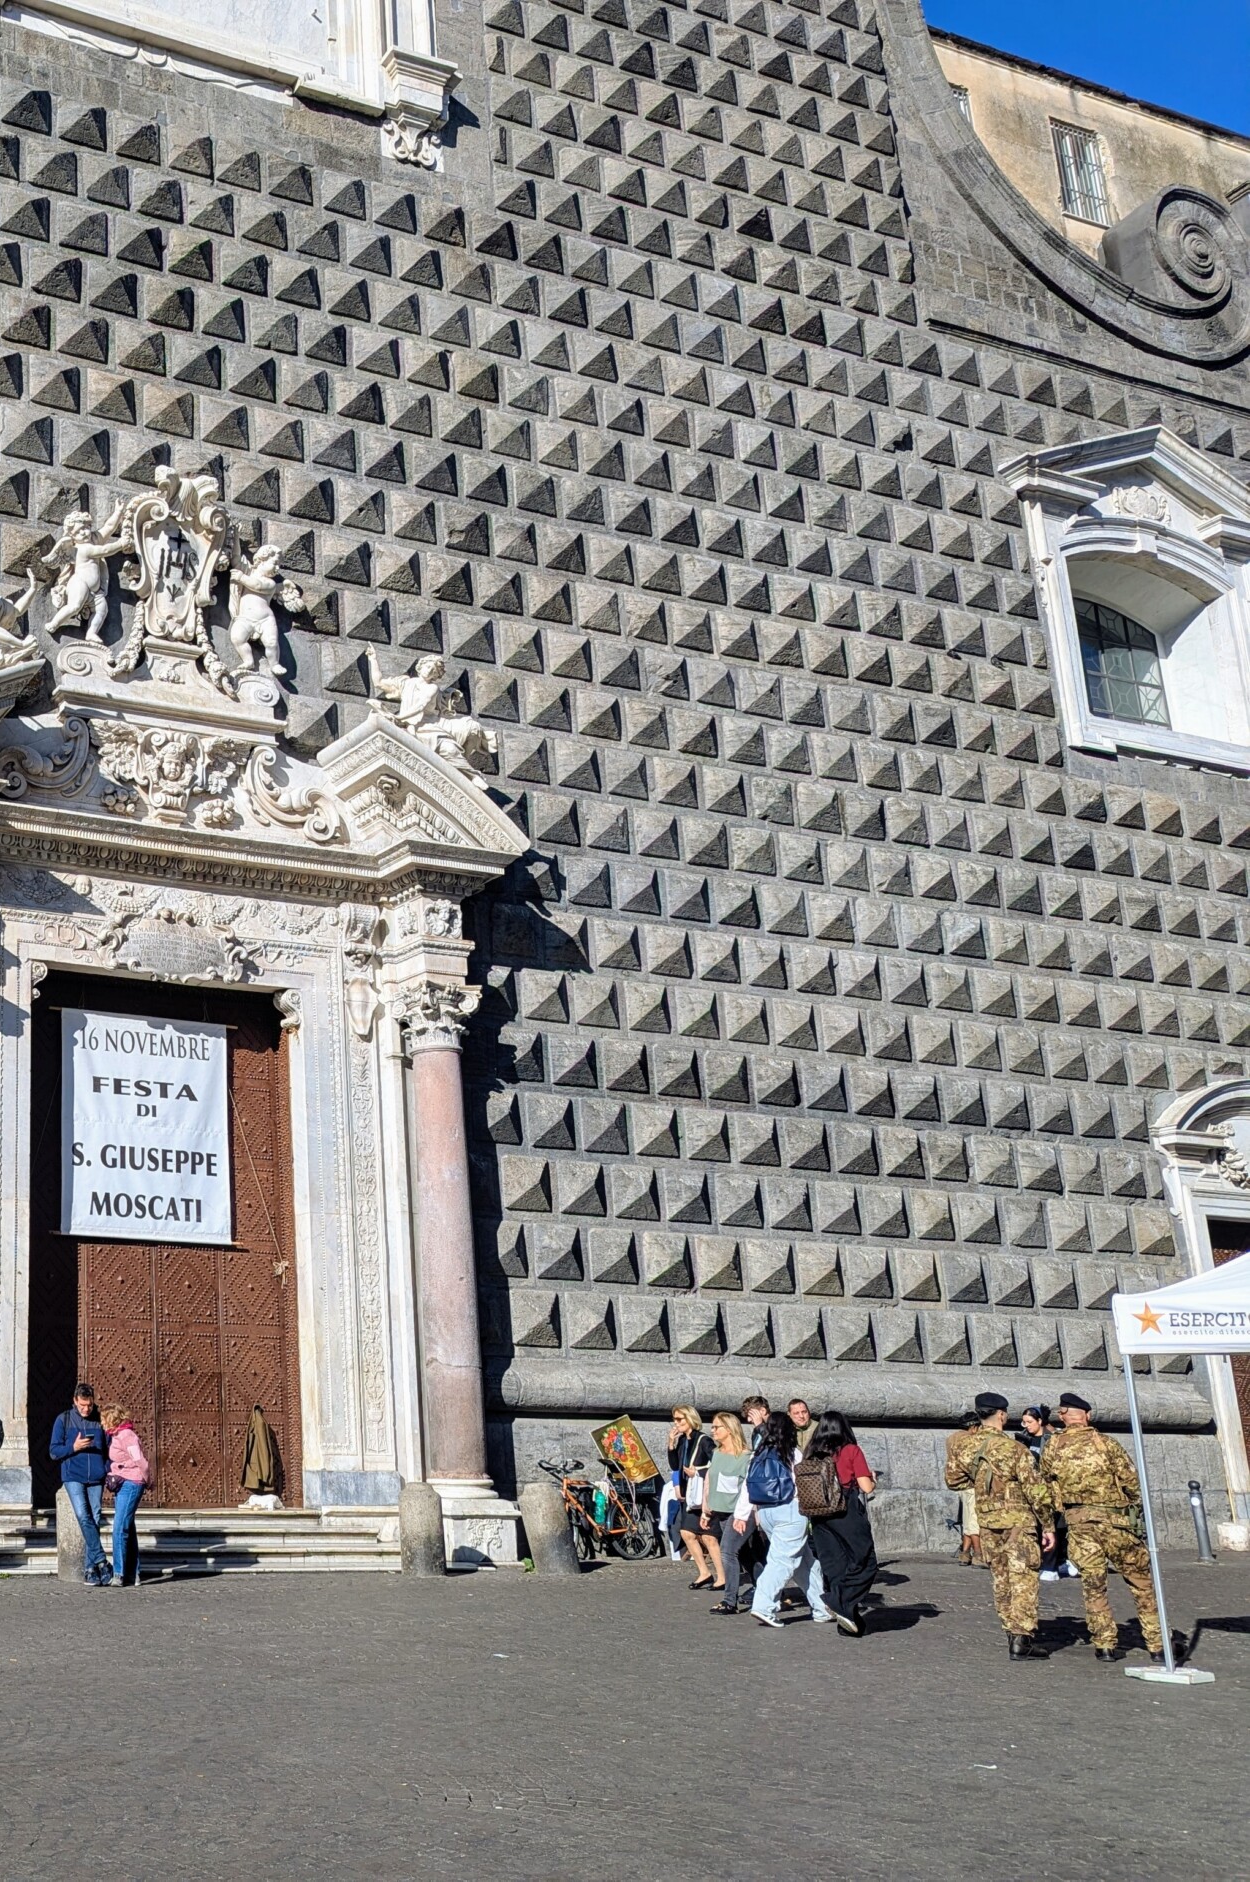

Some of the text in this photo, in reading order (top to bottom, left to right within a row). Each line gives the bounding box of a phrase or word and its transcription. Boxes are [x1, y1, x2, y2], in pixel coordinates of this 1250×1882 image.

[80, 1027, 210, 1061] 16 NOVEMBRE
[92, 1075, 198, 1102] FESTA
[137, 1103, 157, 1118] DI
[71, 1142, 217, 1177] S. GIUSEPPE
[89, 1191, 202, 1223] MOSCATI
[1169, 1312, 1250, 1327] ESERCIT
